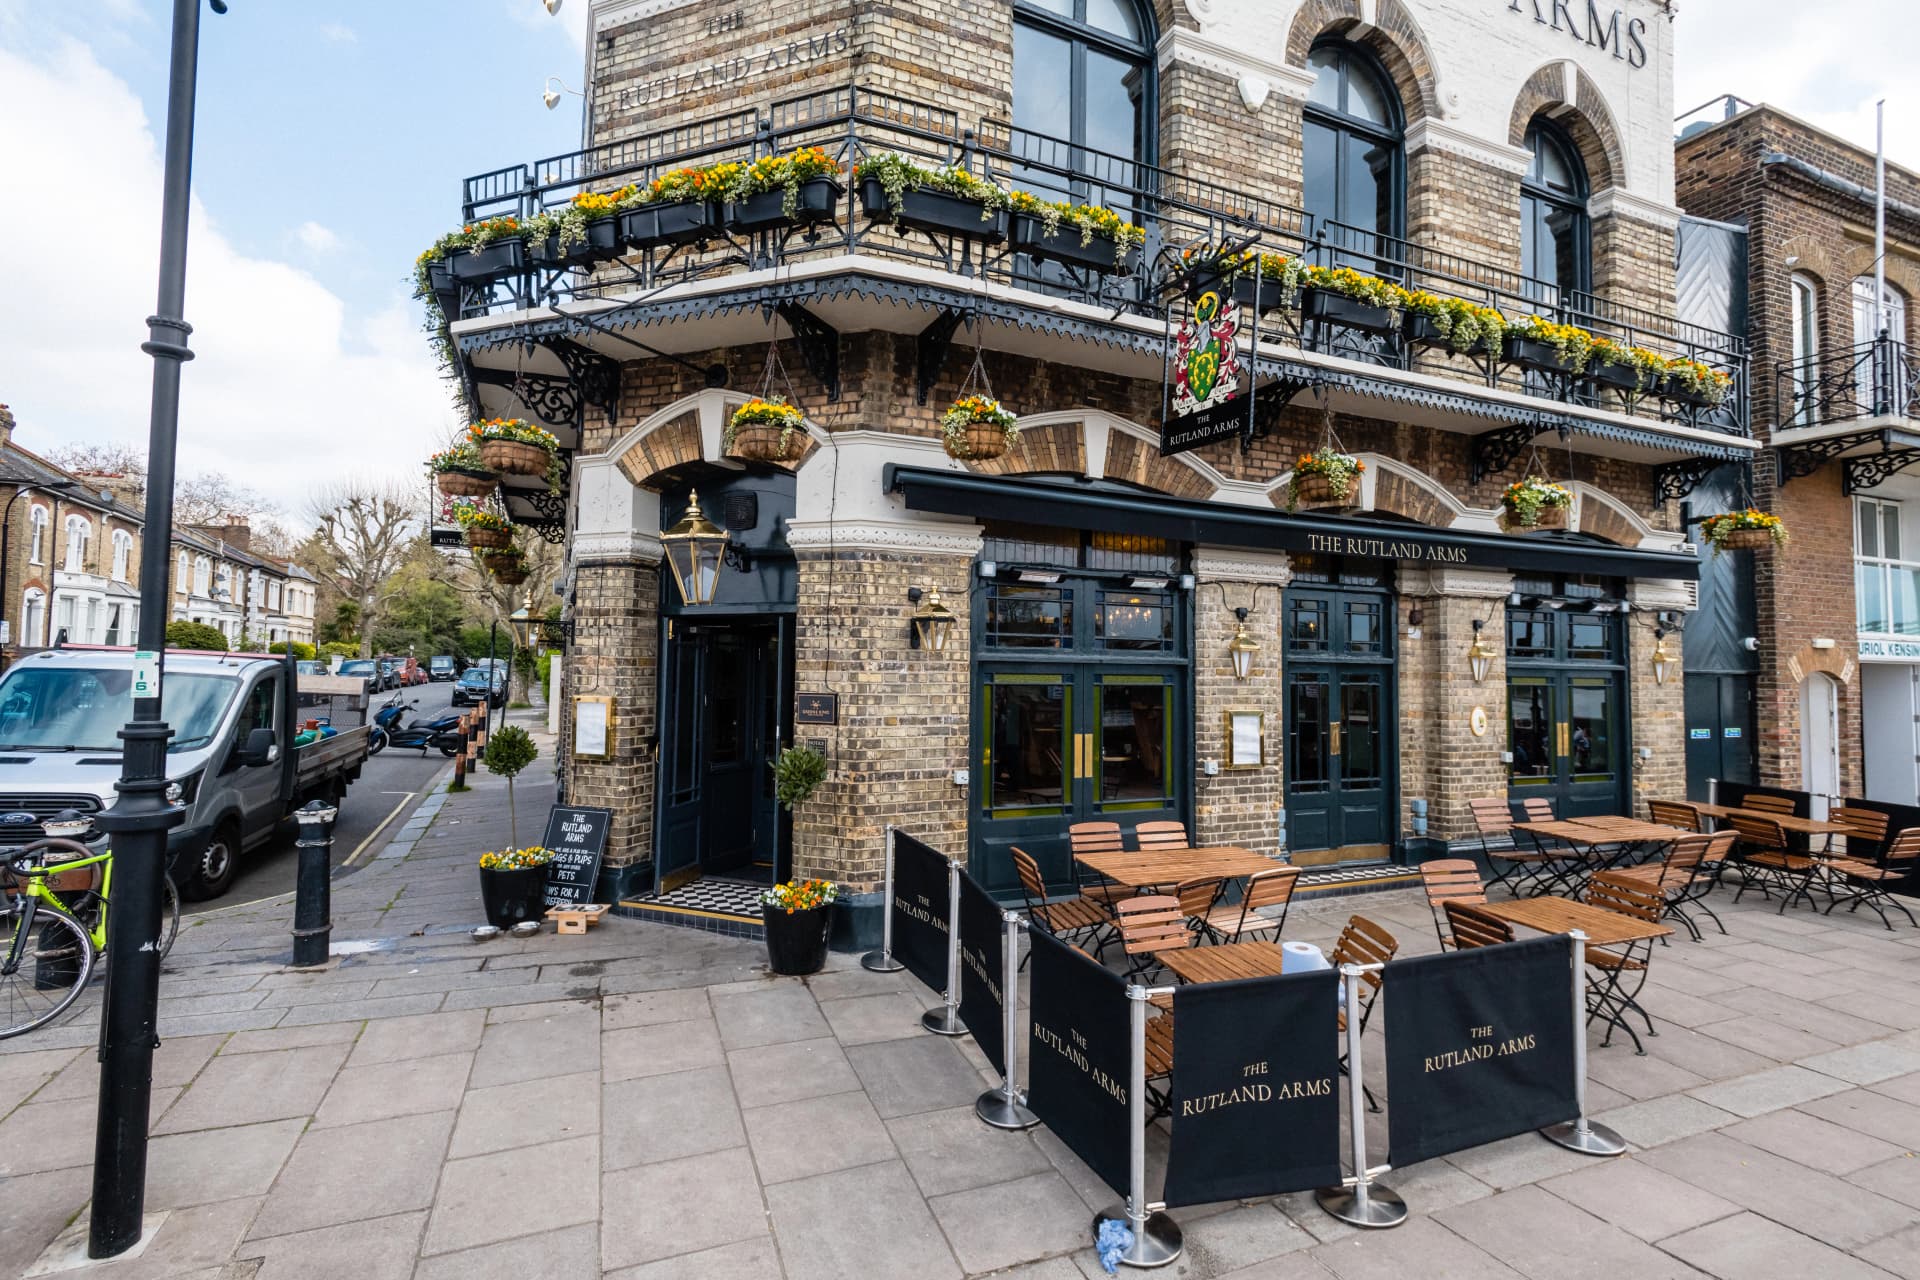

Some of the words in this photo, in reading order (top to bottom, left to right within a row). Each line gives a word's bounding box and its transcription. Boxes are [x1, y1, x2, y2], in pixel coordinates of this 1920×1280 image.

[704, 10, 745, 35] THE
[618, 56, 751, 110] RUTLAND
[764, 28, 848, 72] ARMS
[1197, 414, 1211, 424] THE
[1170, 426, 1211, 447] RUTLAND
[1213, 417, 1240, 435] ARMS
[1308, 534, 1342, 552] THE
[1347, 538, 1422, 560] RUTLAND
[1426, 546, 1467, 563] ARMS
[135, 681, 147, 691] 6
[572, 814, 587, 823] THE
[561, 822, 593, 833] RUTLAND
[564, 832, 585, 843] ARMS
[573, 854, 592, 865] PUPS
[557, 870, 576, 880] PETS
[560, 887, 573, 898] FOR
[573, 888, 580, 899] A
[918, 895, 930, 906] THE
[896, 896, 930, 922] RUTLAND
[931, 915, 950, 934] ARM
[963, 946, 988, 983] RUTLAND
[1071, 1027, 1087, 1050] THE
[1470, 1025, 1493, 1039] THE
[1424, 1044, 1494, 1073] RUTLAND
[1497, 1034, 1536, 1056] ARMS
[1034, 1022, 1089, 1073] RUTLAND
[1092, 1066, 1126, 1105] ARMS
[1243, 1061, 1269, 1077] THE
[1182, 1084, 1272, 1117] RUTLAND
[1278, 1078, 1332, 1100] ARMS
